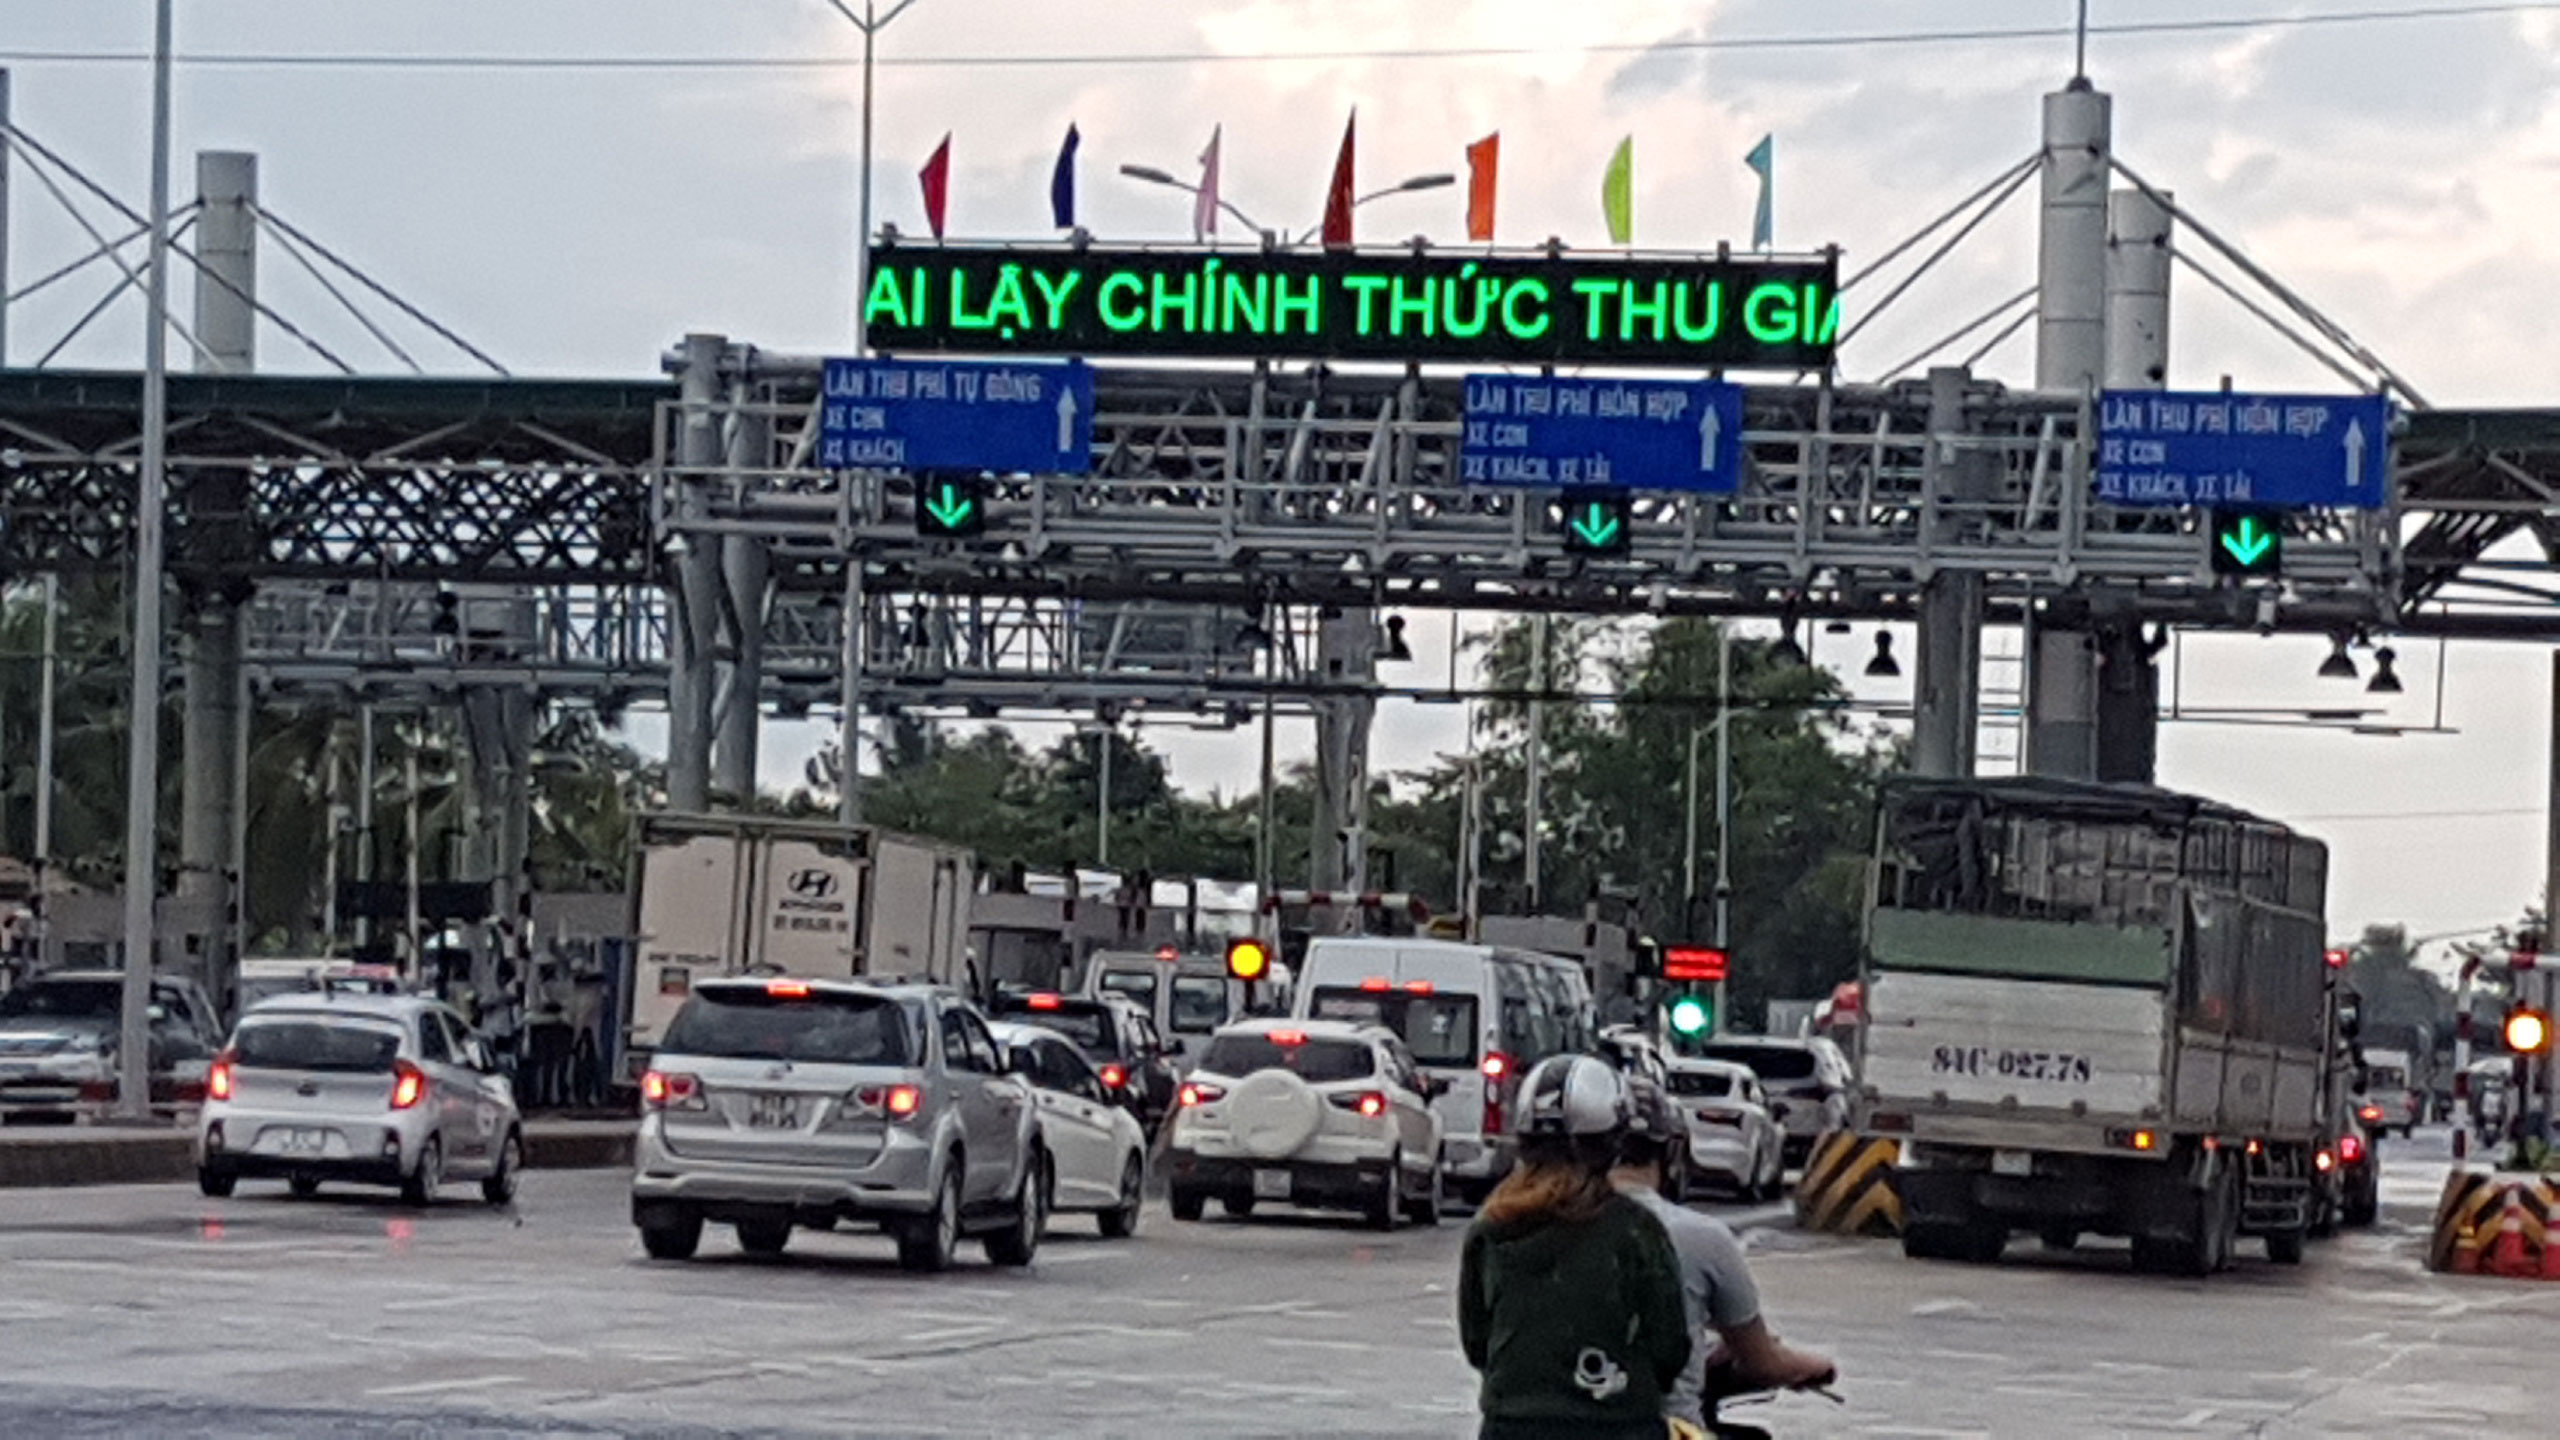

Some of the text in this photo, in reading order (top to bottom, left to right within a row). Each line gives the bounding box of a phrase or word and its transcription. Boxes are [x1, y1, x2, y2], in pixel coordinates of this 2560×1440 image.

[864, 267, 927, 327] AI
[950, 263, 1081, 339] LẬY
[1098, 258, 1320, 334] CHÍNH
[1341, 262, 1550, 341] THỨC
[1571, 279, 1721, 343] THU
[2149, 400, 2190, 432] THU
[2195, 399, 2231, 434] PHÍ
